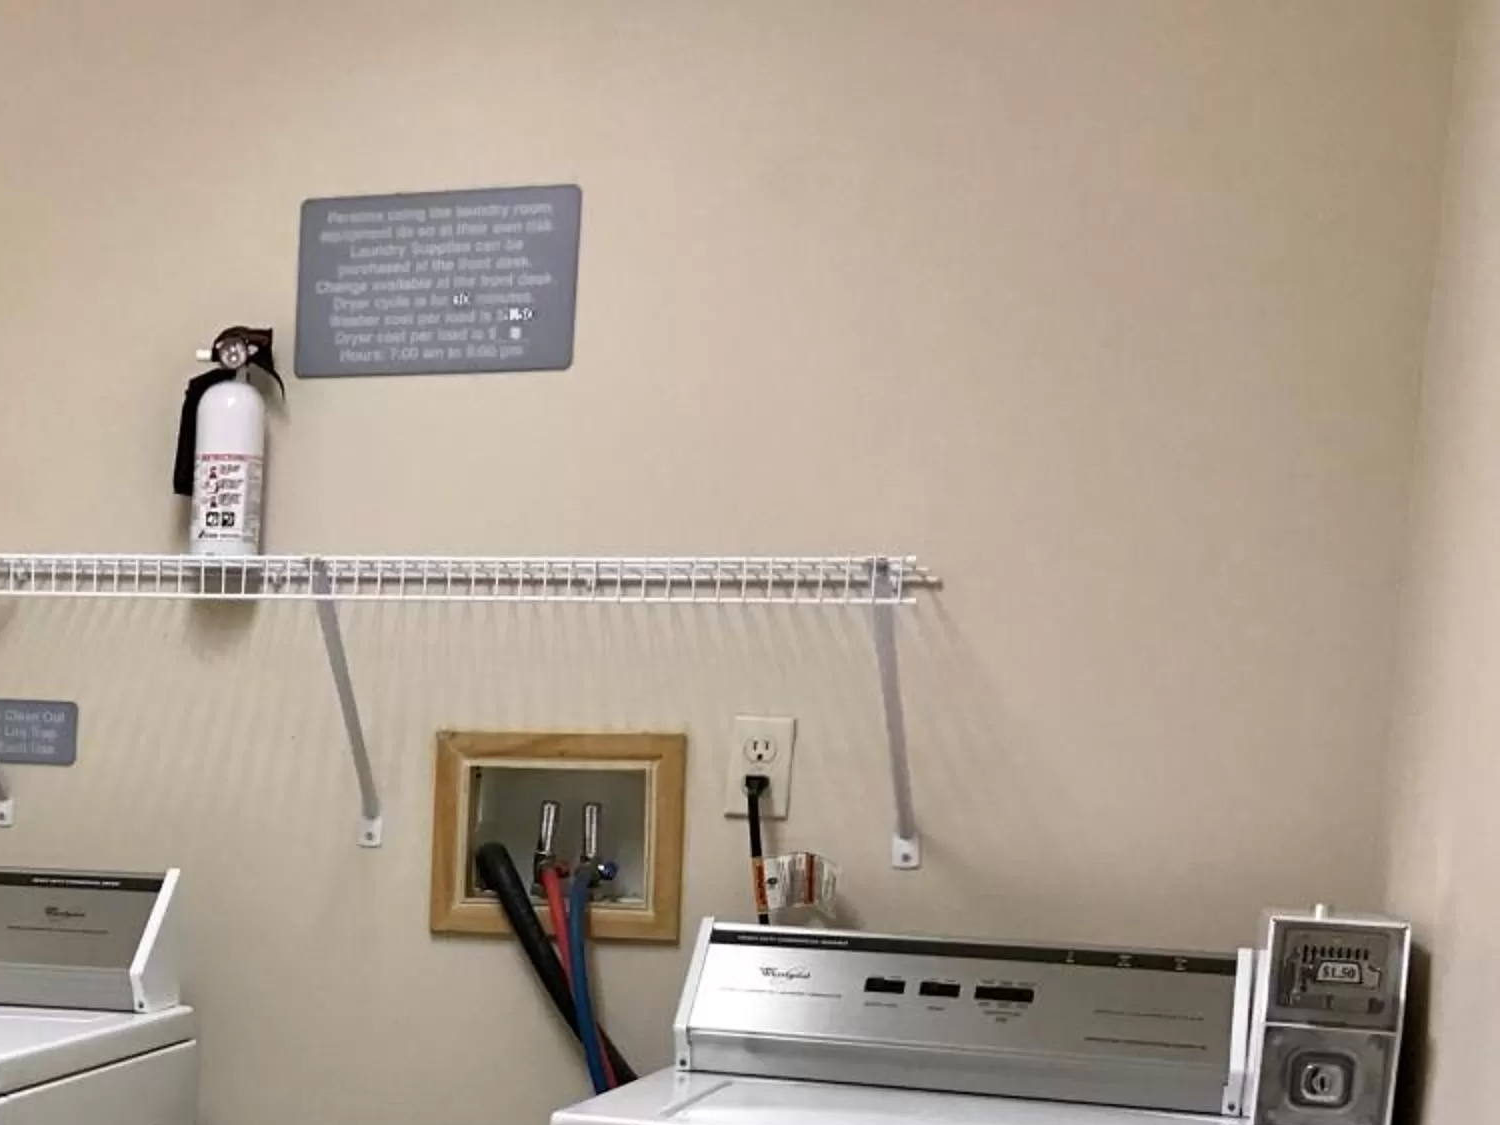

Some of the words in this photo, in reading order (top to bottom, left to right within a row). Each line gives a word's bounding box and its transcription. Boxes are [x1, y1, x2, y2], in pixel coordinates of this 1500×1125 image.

[428, 206, 452, 219] the
[456, 206, 508, 220] laundry
[512, 203, 553, 217] room
[492, 224, 522, 235] own
[350, 246, 405, 259] Laundry
[411, 242, 470, 257] Supplies
[475, 241, 500, 253] can
[504, 240, 524, 252] be
[431, 259, 454, 273] the
[457, 258, 491, 271] front
[316, 282, 368, 297] Change
[372, 278, 432, 291] available
[453, 276, 475, 289] the
[480, 274, 513, 287] front
[333, 297, 370, 312] Dryer
[335, 331, 372, 347] Dryer
[4, 708, 39, 722] Clean
[42, 711, 66, 723] Out
[759, 965, 812, 981] Whirlpool
[1323, 964, 1356, 979] $1.50
